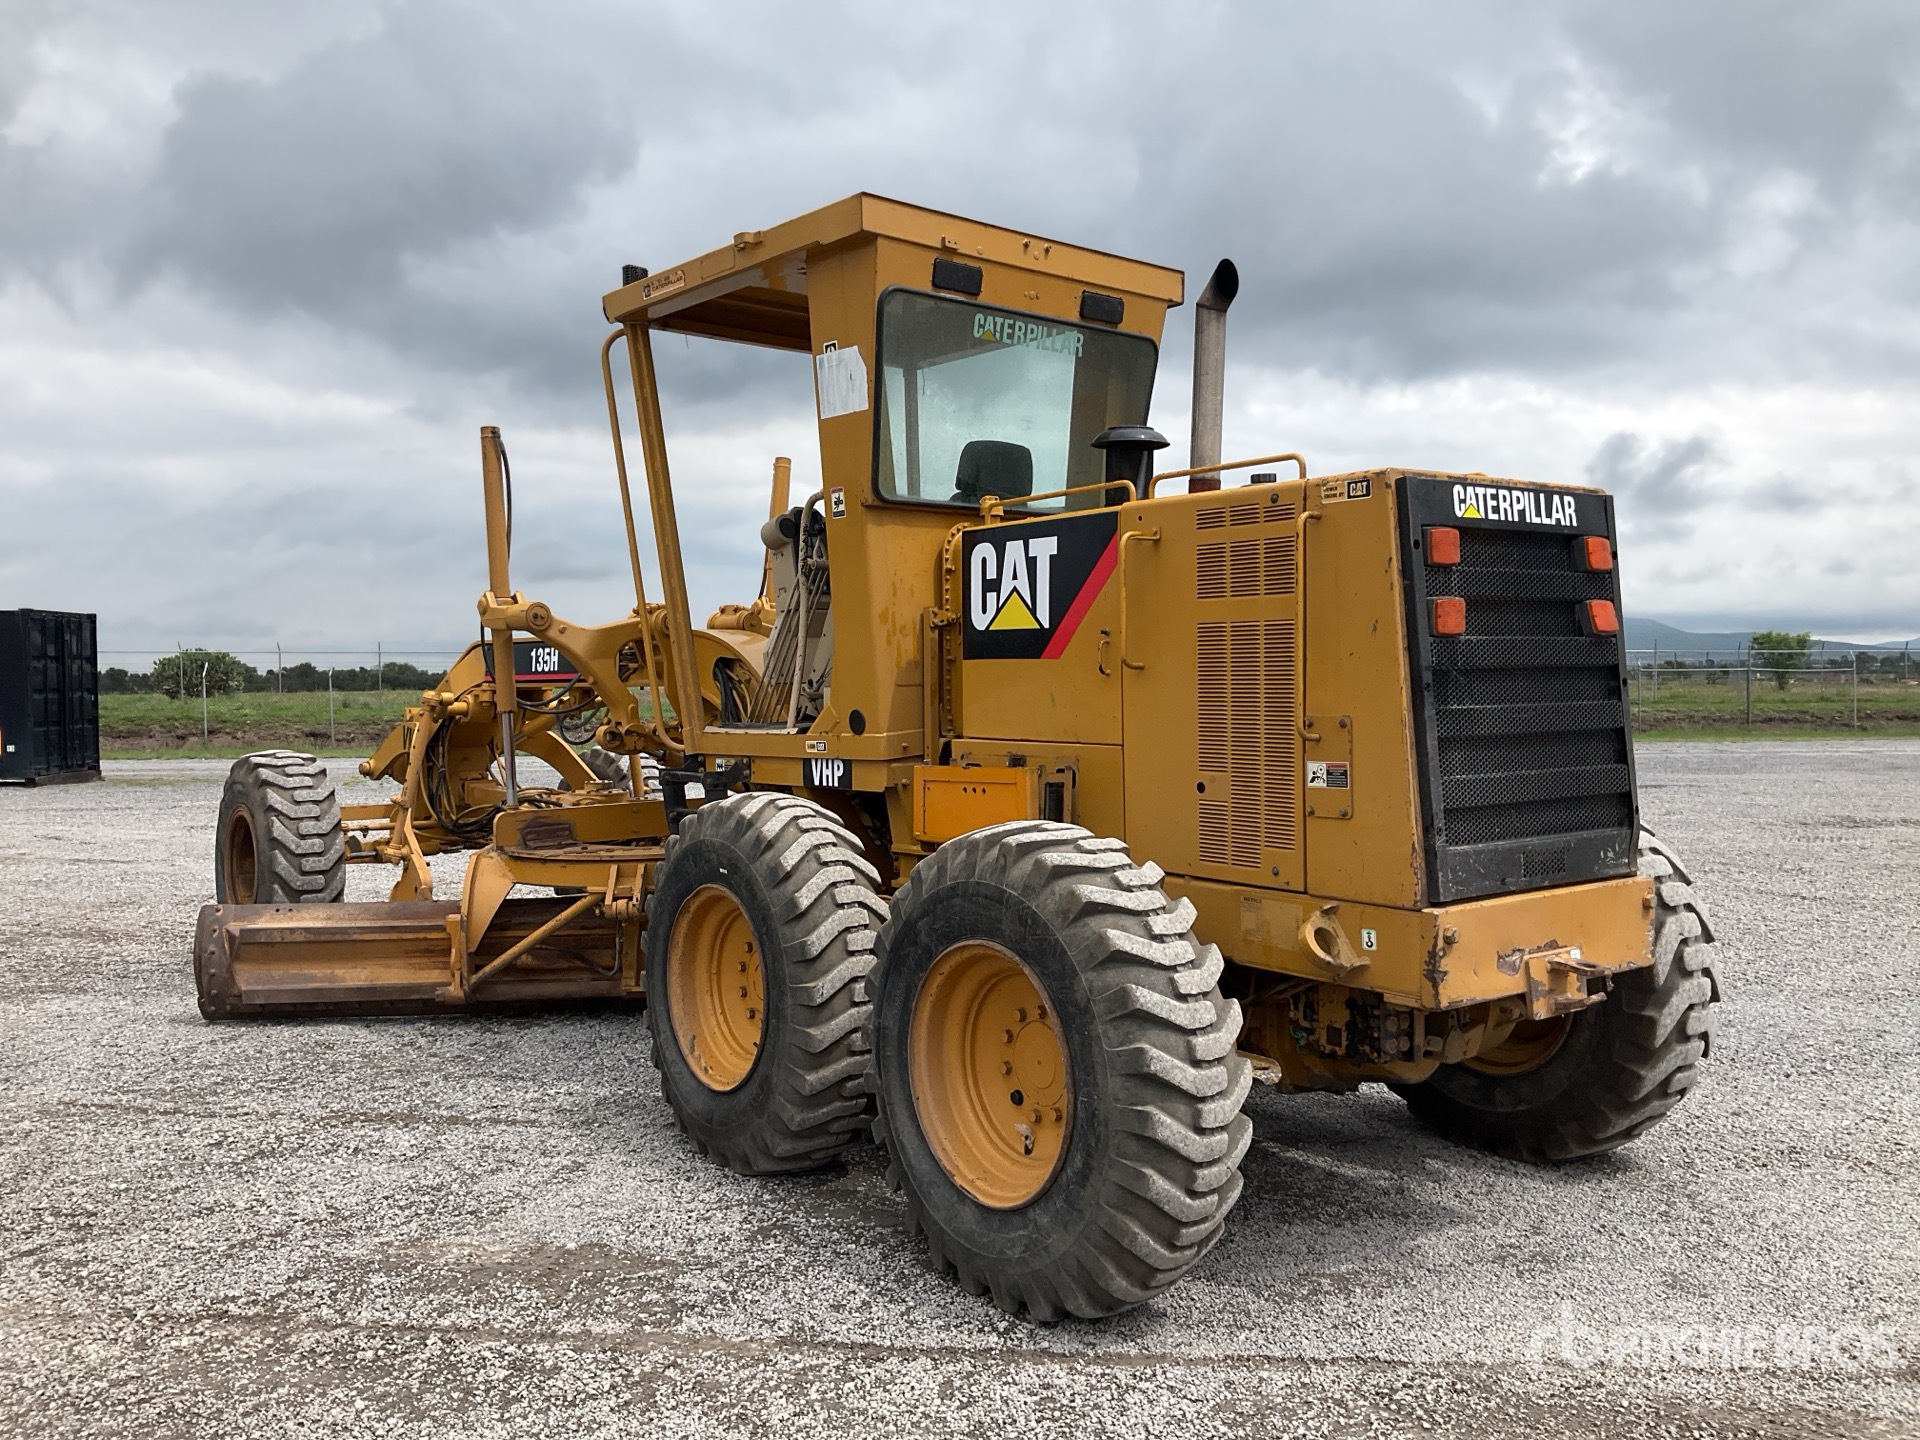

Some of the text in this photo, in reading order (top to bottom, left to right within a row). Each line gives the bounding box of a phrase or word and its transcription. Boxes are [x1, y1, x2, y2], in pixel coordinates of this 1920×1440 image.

[973, 313, 1084, 357] CATERPILLAR
[1349, 481, 1368, 497] CAT
[1452, 484, 1578, 527] CATERPILLAR
[970, 535, 1058, 631] CAT
[530, 647, 559, 672] 135H
[811, 758, 844, 787] VHP
